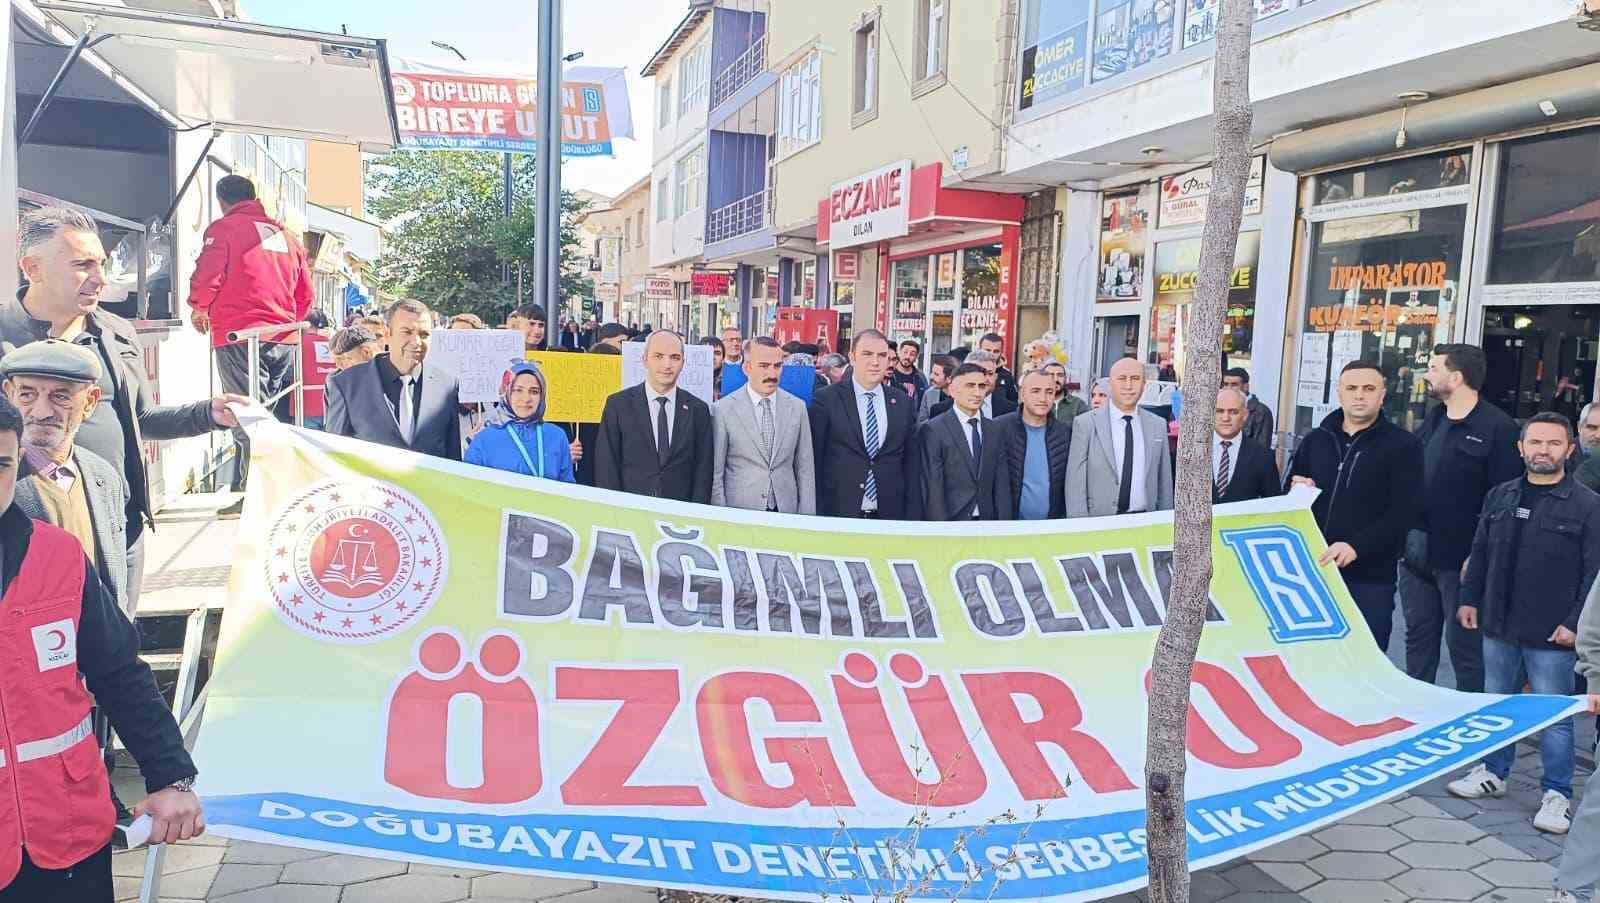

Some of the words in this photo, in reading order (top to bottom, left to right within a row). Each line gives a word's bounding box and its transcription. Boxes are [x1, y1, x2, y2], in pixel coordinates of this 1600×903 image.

[421, 81, 512, 104] TOPLUMA
[400, 105, 506, 135] BİREYE
[515, 110, 599, 140] UUT
[832, 169, 902, 224] ECZANE
[1328, 256, 1447, 290] İMPARATOR
[371, 512, 408, 543] ADALET
[502, 512, 939, 639] BAĞIMLI
[384, 632, 1141, 808] ÖZGÜR
[1144, 654, 1416, 769] OL
[258, 799, 697, 871] DOĞUBAYAZIT
[712, 838, 985, 882] DENETİMLİ
[986, 807, 1265, 881] SERBESLİK
[1253, 714, 1515, 824] MÜDÜRLÜĞÜ
